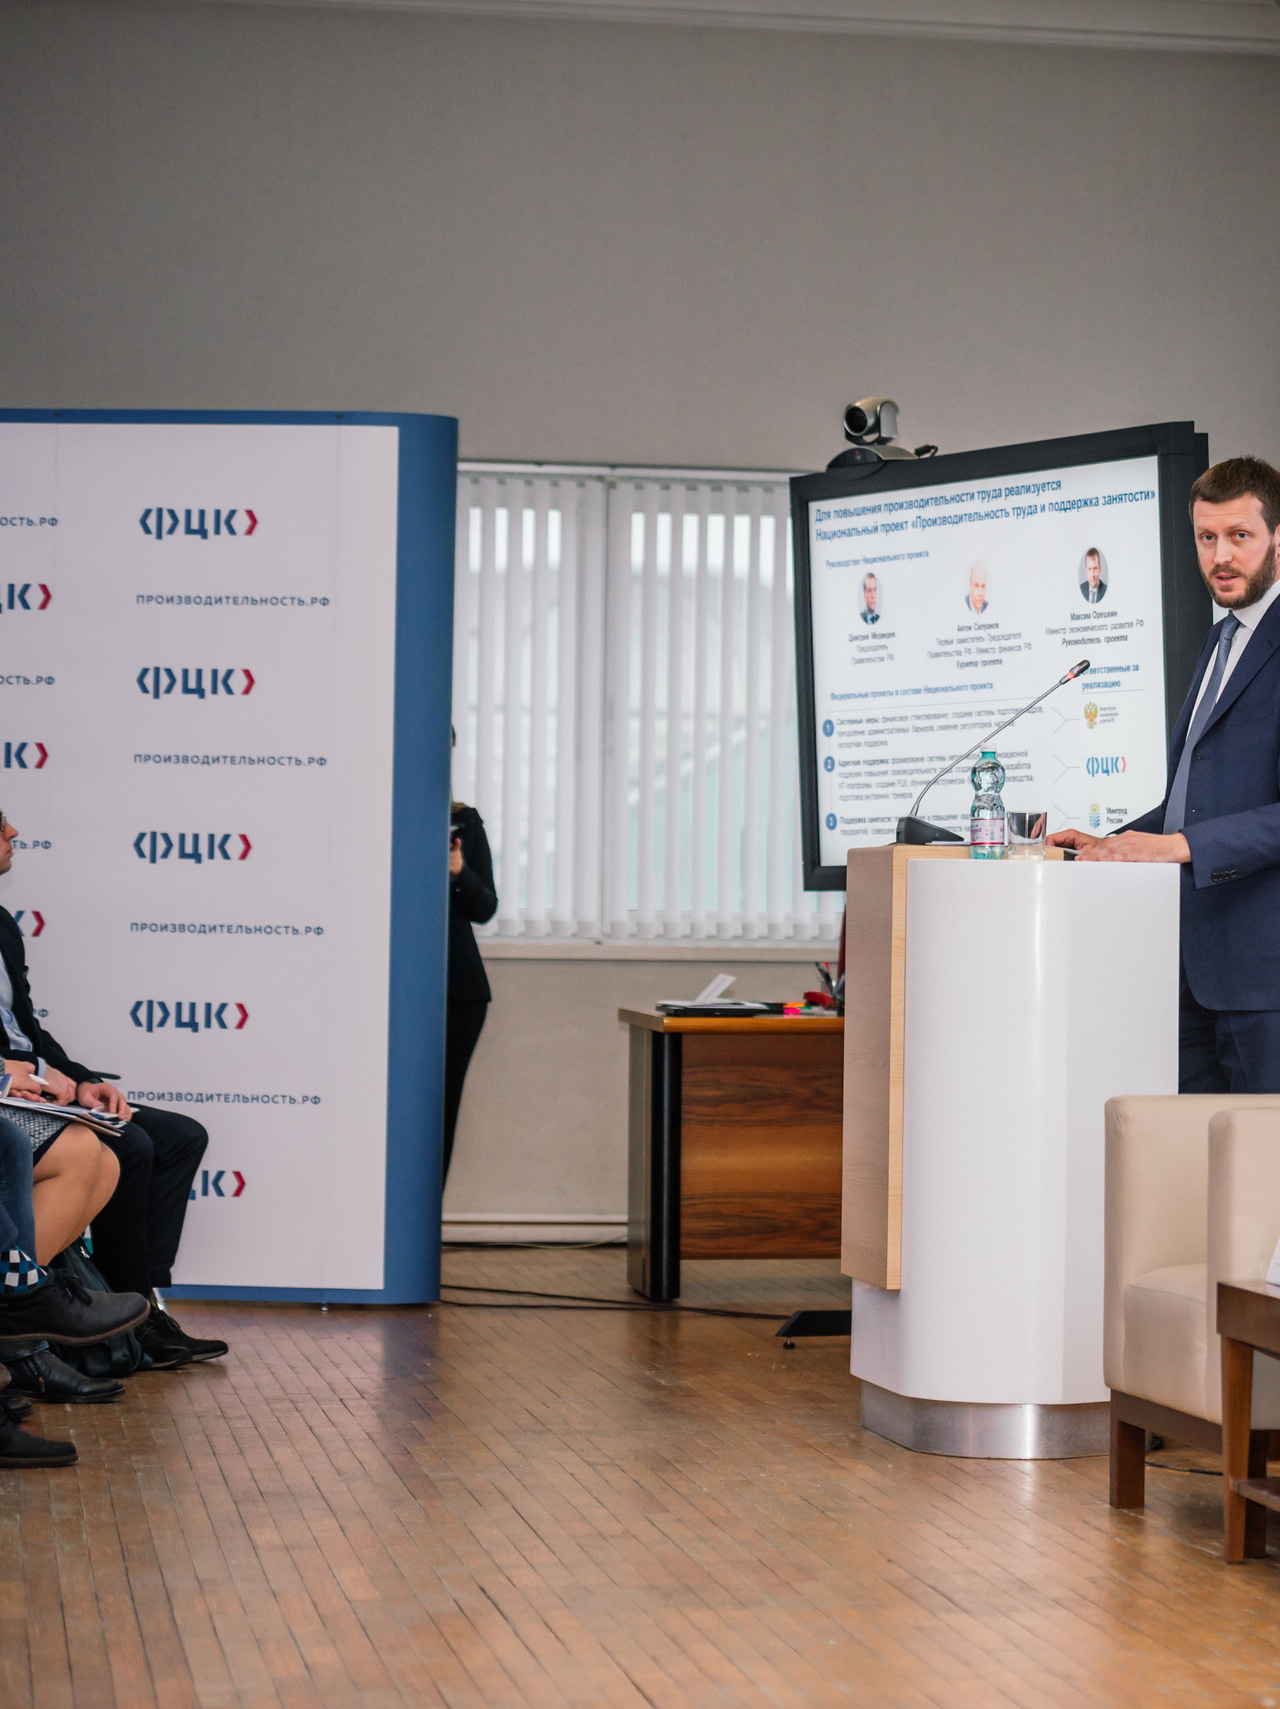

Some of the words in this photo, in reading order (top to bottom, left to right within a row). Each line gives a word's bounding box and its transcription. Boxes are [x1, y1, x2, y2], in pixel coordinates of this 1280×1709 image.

[815, 507, 831, 524] Для
[833, 503, 882, 520] повышения
[884, 489, 975, 515] производительности
[976, 487, 1002, 504] труда
[1004, 479, 1062, 501] реализуется
[816, 521, 878, 542] Национальный
[880, 519, 909, 536] проект
[911, 507, 1010, 531] «Производительность
[1012, 503, 1038, 520] труда
[1040, 503, 1046, 513] и
[1048, 496, 1100, 514] поддержка
[1101, 488, 1155, 506] занятости»
[825, 556, 860, 571] Руководство
[861, 551, 905, 565] Национального
[906, 549, 930, 562] проекта
[136, 593, 331, 609] ПРОИЗВОДИТЕЛЬНОСТЬ.РФ
[1070, 611, 1092, 621] Максим
[1092, 610, 1118, 621] Орешкин
[1104, 633, 1128, 645] проекта
[1081, 665, 1131, 676] тветственные
[1132, 663, 1140, 672] за
[1082, 679, 1121, 692] реализацию
[133, 753, 327, 768] ПРОИЗВОДИТЕЛЬНОСТЬ.РФ
[1106, 806, 1128, 816] Минтруд
[130, 921, 324, 937] ПРОИЗВОДИТЕЛЬНОСТЬ.РФ
[127, 1090, 321, 1106] ПРОИЗВОДИТЕЛЬНОСТЬ.РФ
